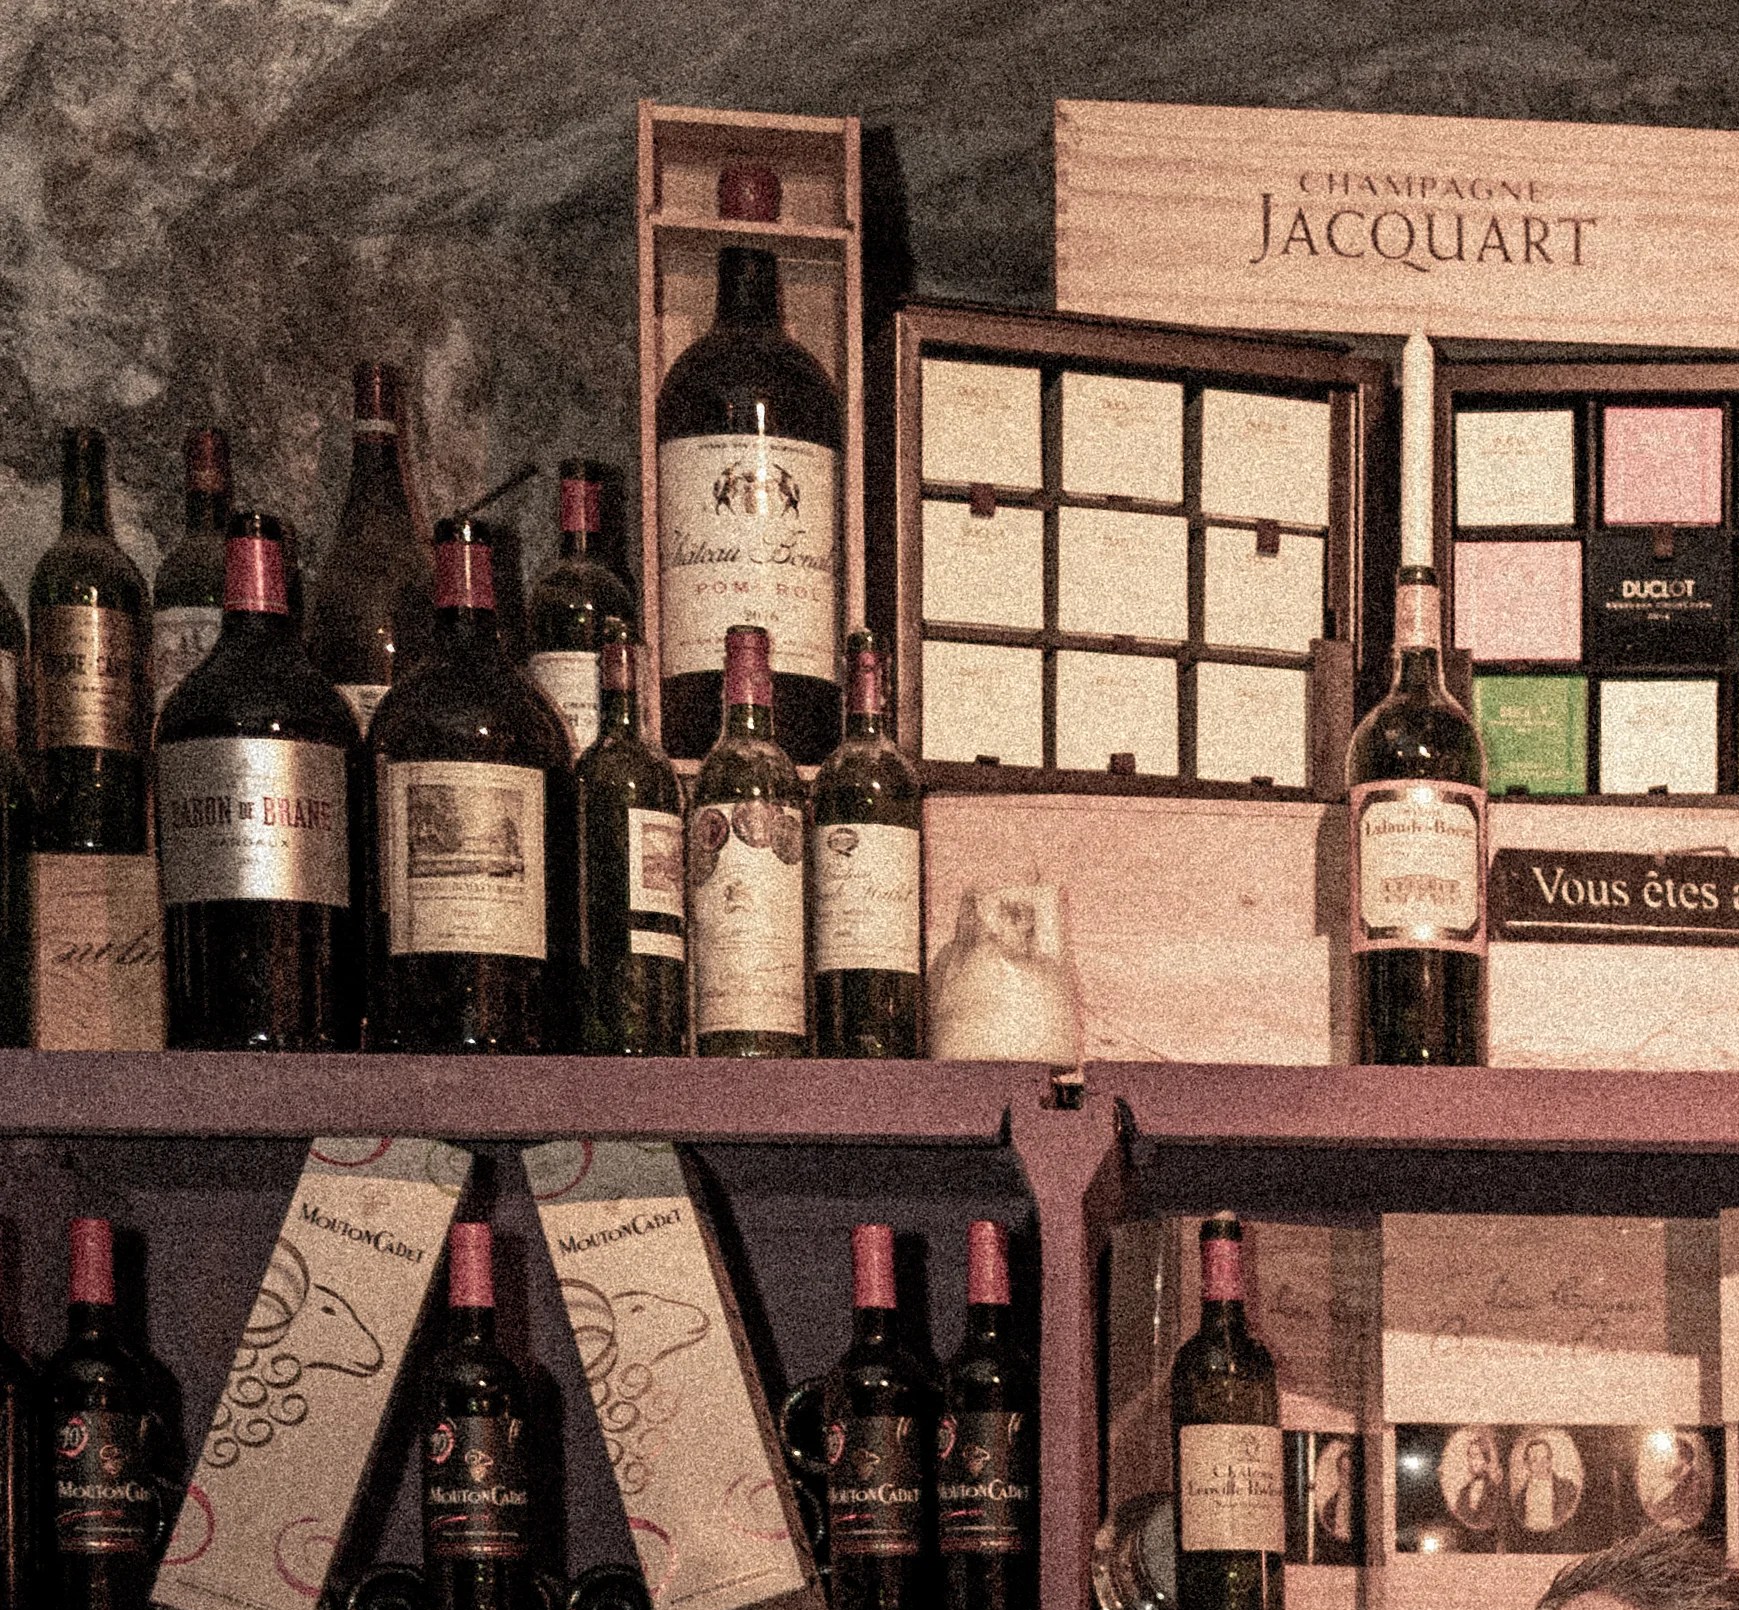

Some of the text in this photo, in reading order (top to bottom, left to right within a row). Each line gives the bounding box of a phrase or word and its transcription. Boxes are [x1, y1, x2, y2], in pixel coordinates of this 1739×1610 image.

[1298, 171, 1546, 202] CHAMPAGNE
[1248, 191, 1597, 273] JACQUART
[1621, 578, 1696, 599] DUCLOT
[261, 795, 333, 832] BRANE
[1532, 866, 1631, 908] Vous
[1642, 870, 1720, 911] êtes
